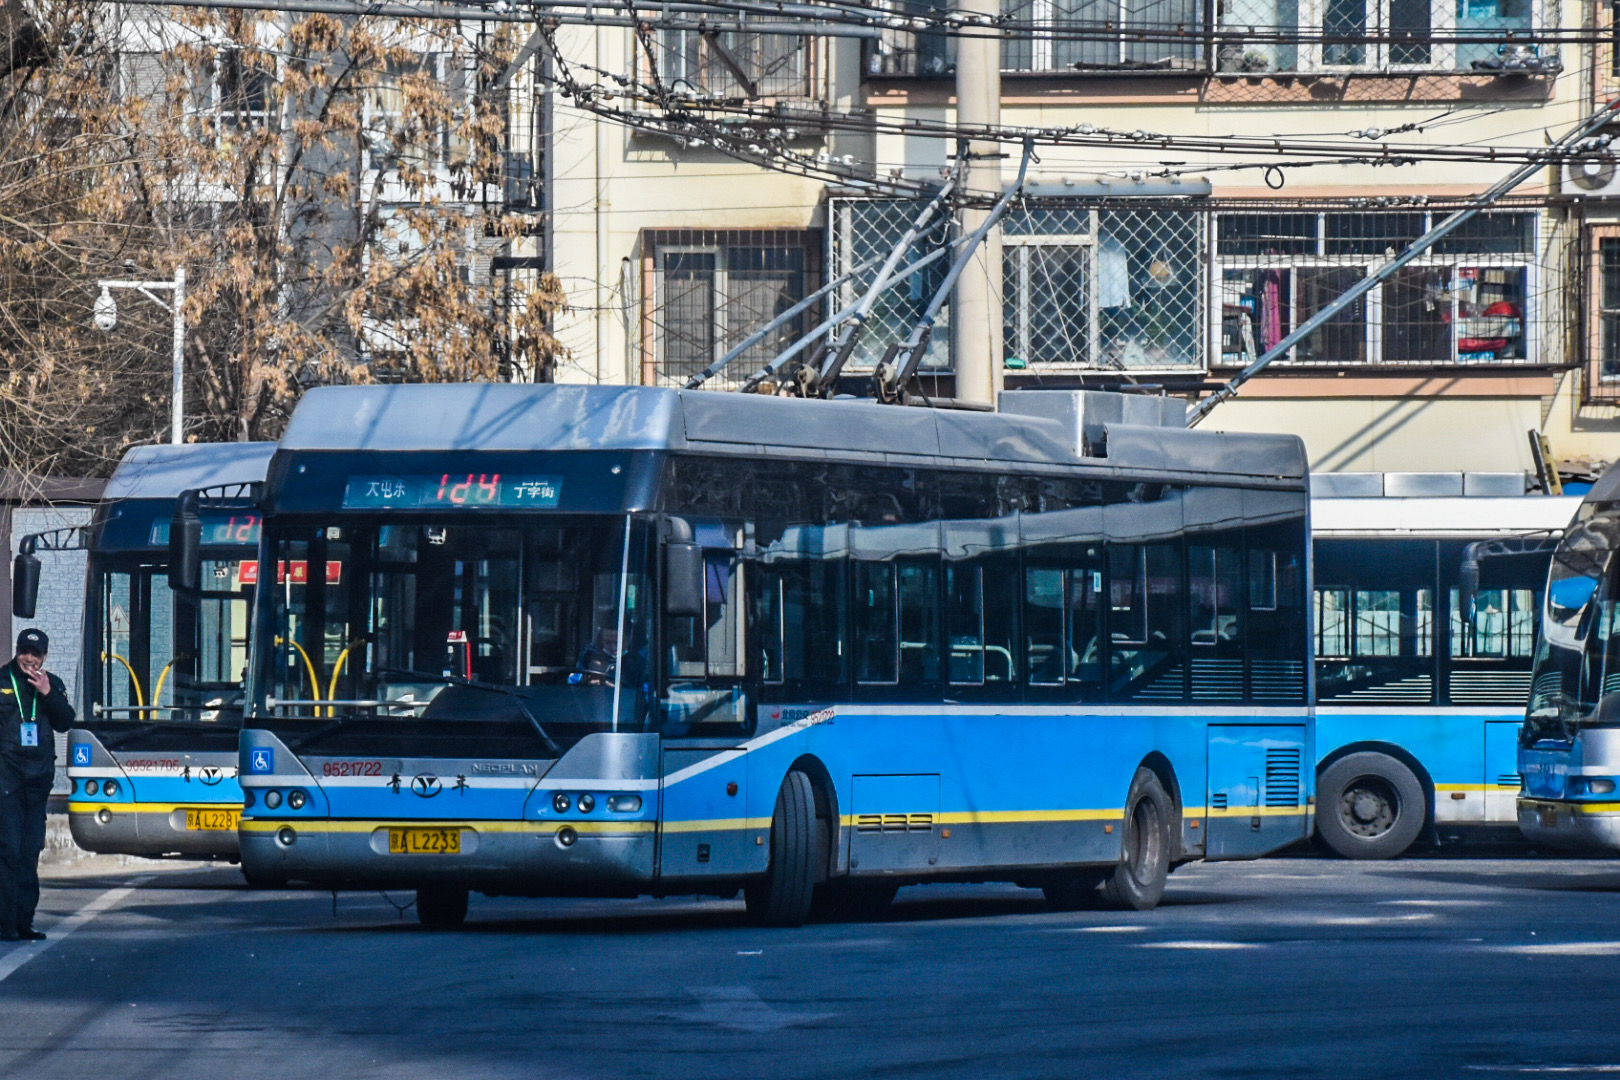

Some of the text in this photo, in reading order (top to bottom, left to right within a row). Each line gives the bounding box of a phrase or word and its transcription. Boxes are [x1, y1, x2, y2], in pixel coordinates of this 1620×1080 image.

[224, 515, 263, 542] 12
[322, 761, 382, 777] 9521722
[471, 763, 539, 776] NEOPLAN
